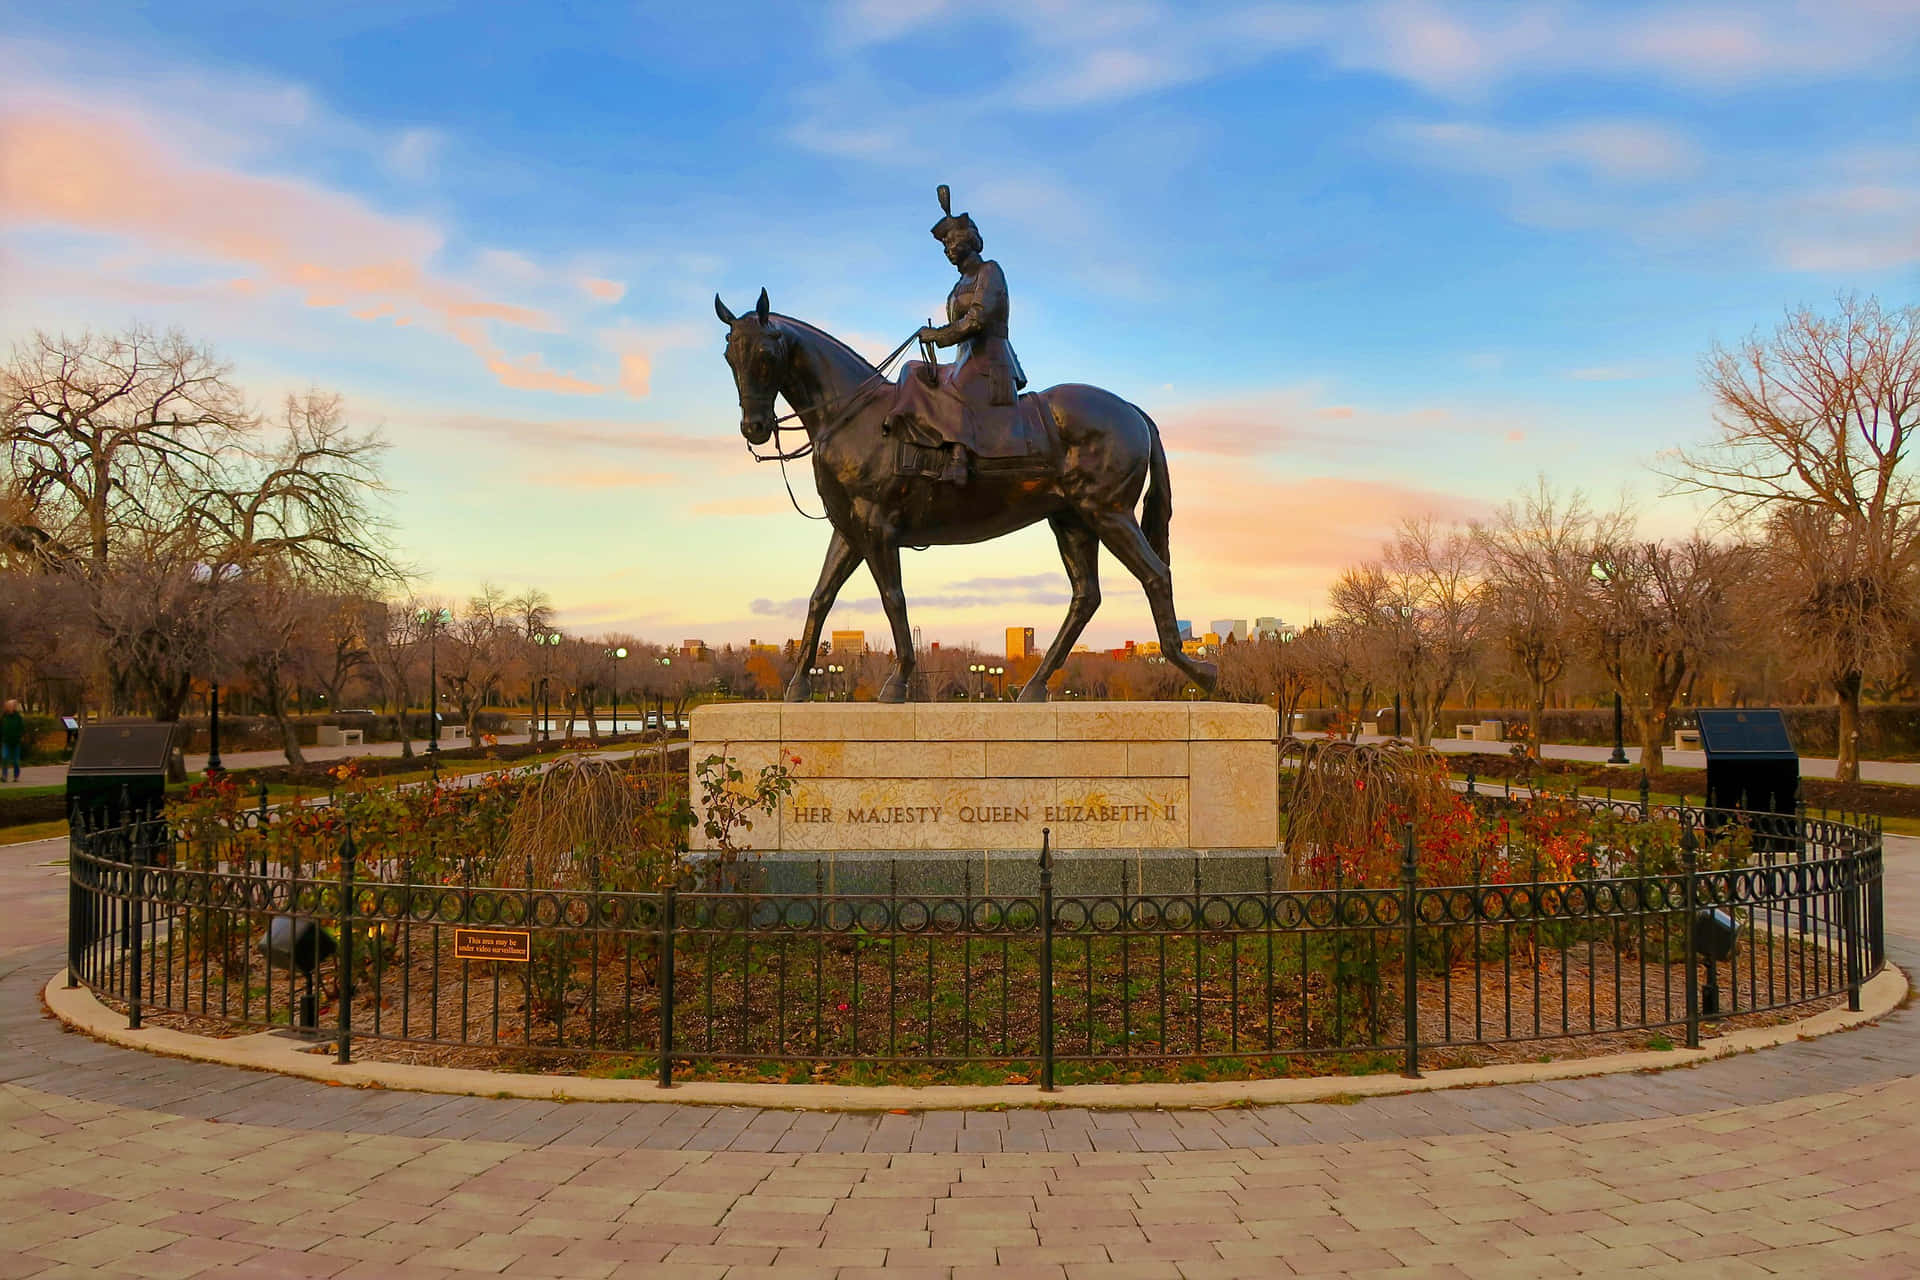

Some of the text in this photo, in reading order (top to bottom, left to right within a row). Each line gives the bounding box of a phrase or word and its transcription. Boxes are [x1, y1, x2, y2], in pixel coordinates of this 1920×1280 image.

[794, 805, 1177, 823] HER MAJESTY QUEEN ELIZABETH II
[468, 936, 480, 945] This
[459, 944, 474, 952] under
[476, 945, 491, 953] video
